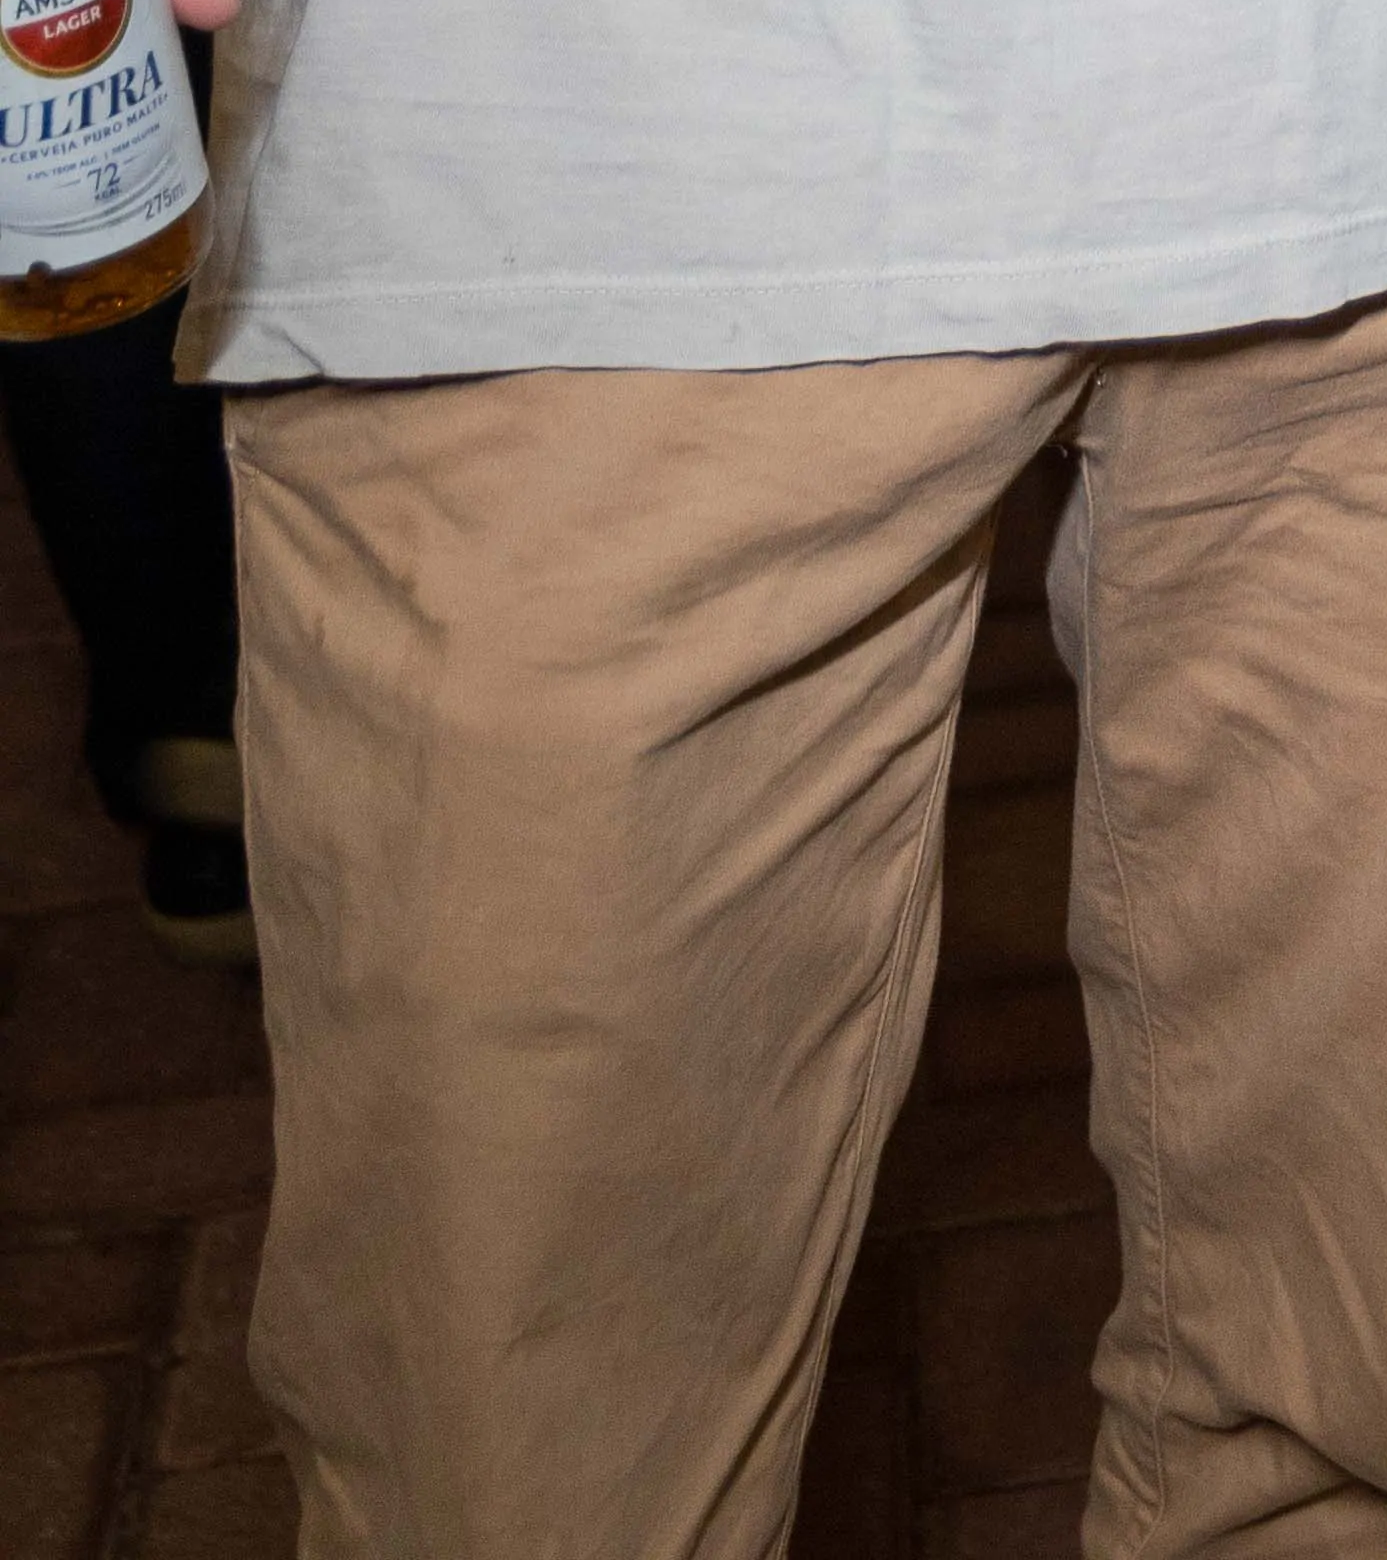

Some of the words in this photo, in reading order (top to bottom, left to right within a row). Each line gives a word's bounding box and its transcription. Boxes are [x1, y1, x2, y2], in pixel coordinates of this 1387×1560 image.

[43, 5, 102, 40] LAGER
[0, 50, 164, 148] ULTRA
[9, 141, 78, 163] CERVEJA
[83, 121, 122, 147] PURO
[127, 96, 164, 127] MALTE
[87, 162, 121, 191] 72
